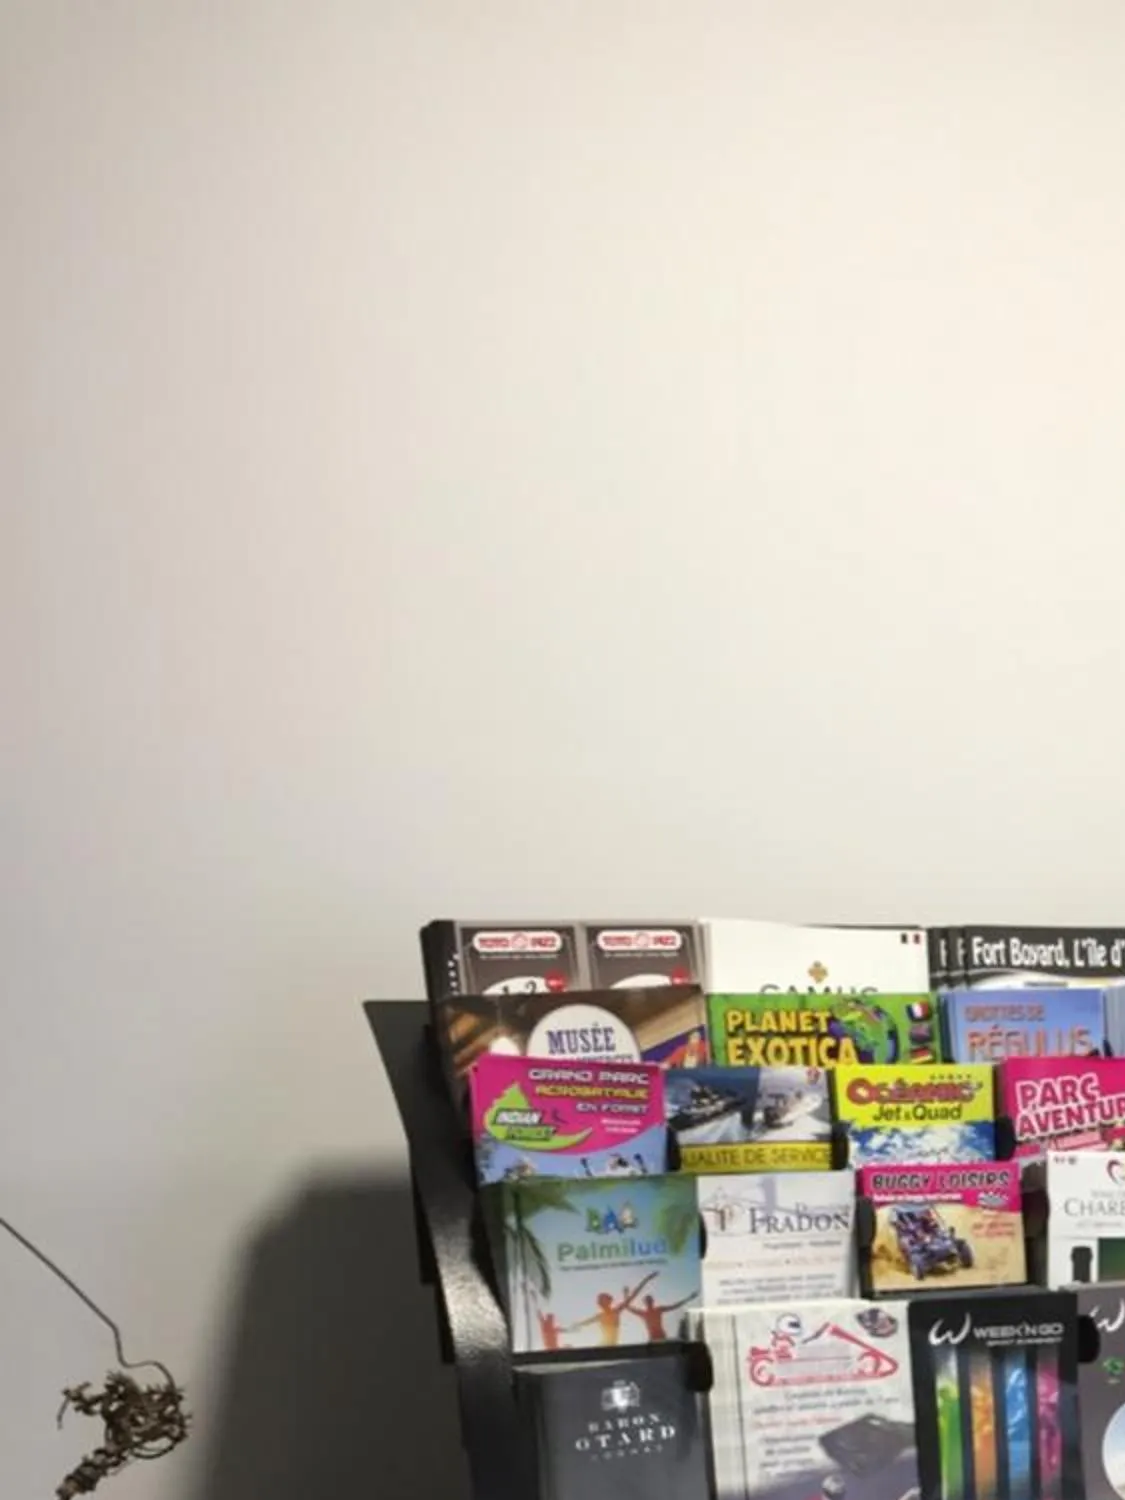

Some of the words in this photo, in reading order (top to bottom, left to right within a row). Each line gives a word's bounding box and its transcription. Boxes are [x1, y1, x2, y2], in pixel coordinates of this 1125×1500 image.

[971, 936, 1005, 966] Fort
[727, 1010, 833, 1033] PLANET
[546, 1021, 616, 1055] MUSÉE
[728, 1036, 859, 1068] EXOTICA
[1015, 1072, 1102, 1111] PARC
[873, 1104, 901, 1121] Jet
[913, 1102, 961, 1121] Quad
[872, 1173, 930, 1189] BUGGY
[939, 1171, 1010, 1188] LOISIRS
[574, 1424, 677, 1452] OTARD
